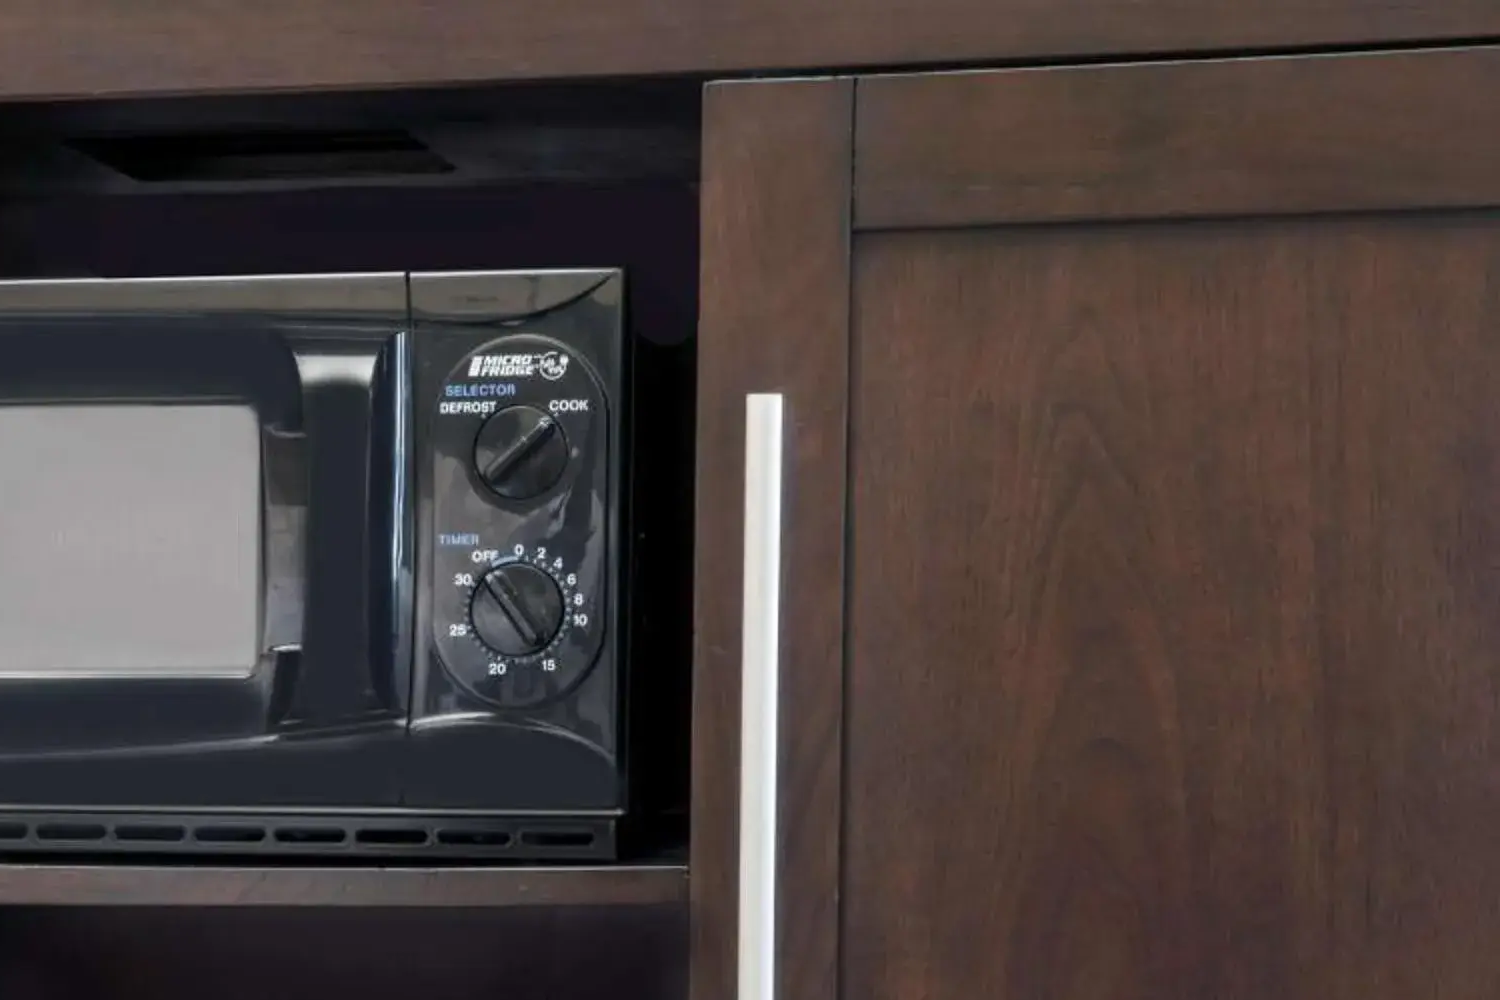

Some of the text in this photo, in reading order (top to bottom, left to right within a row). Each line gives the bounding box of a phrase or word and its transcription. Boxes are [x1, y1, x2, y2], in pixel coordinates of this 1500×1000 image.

[483, 354, 534, 366] MICRO
[445, 383, 517, 397] SELECTOR
[439, 401, 497, 414] DEFROST
[549, 399, 589, 412] COOK
[439, 533, 479, 546] TIMER
[471, 550, 499, 562] OFF
[514, 544, 525, 557] 0
[537, 547, 547, 559] 2
[553, 556, 563, 569] 4
[454, 573, 473, 585] 30
[567, 573, 577, 585] 6
[573, 593, 583, 605] 8
[573, 613, 588, 626] 10
[449, 623, 467, 636] 25
[488, 663, 507, 675] 20
[542, 659, 556, 672] 15
